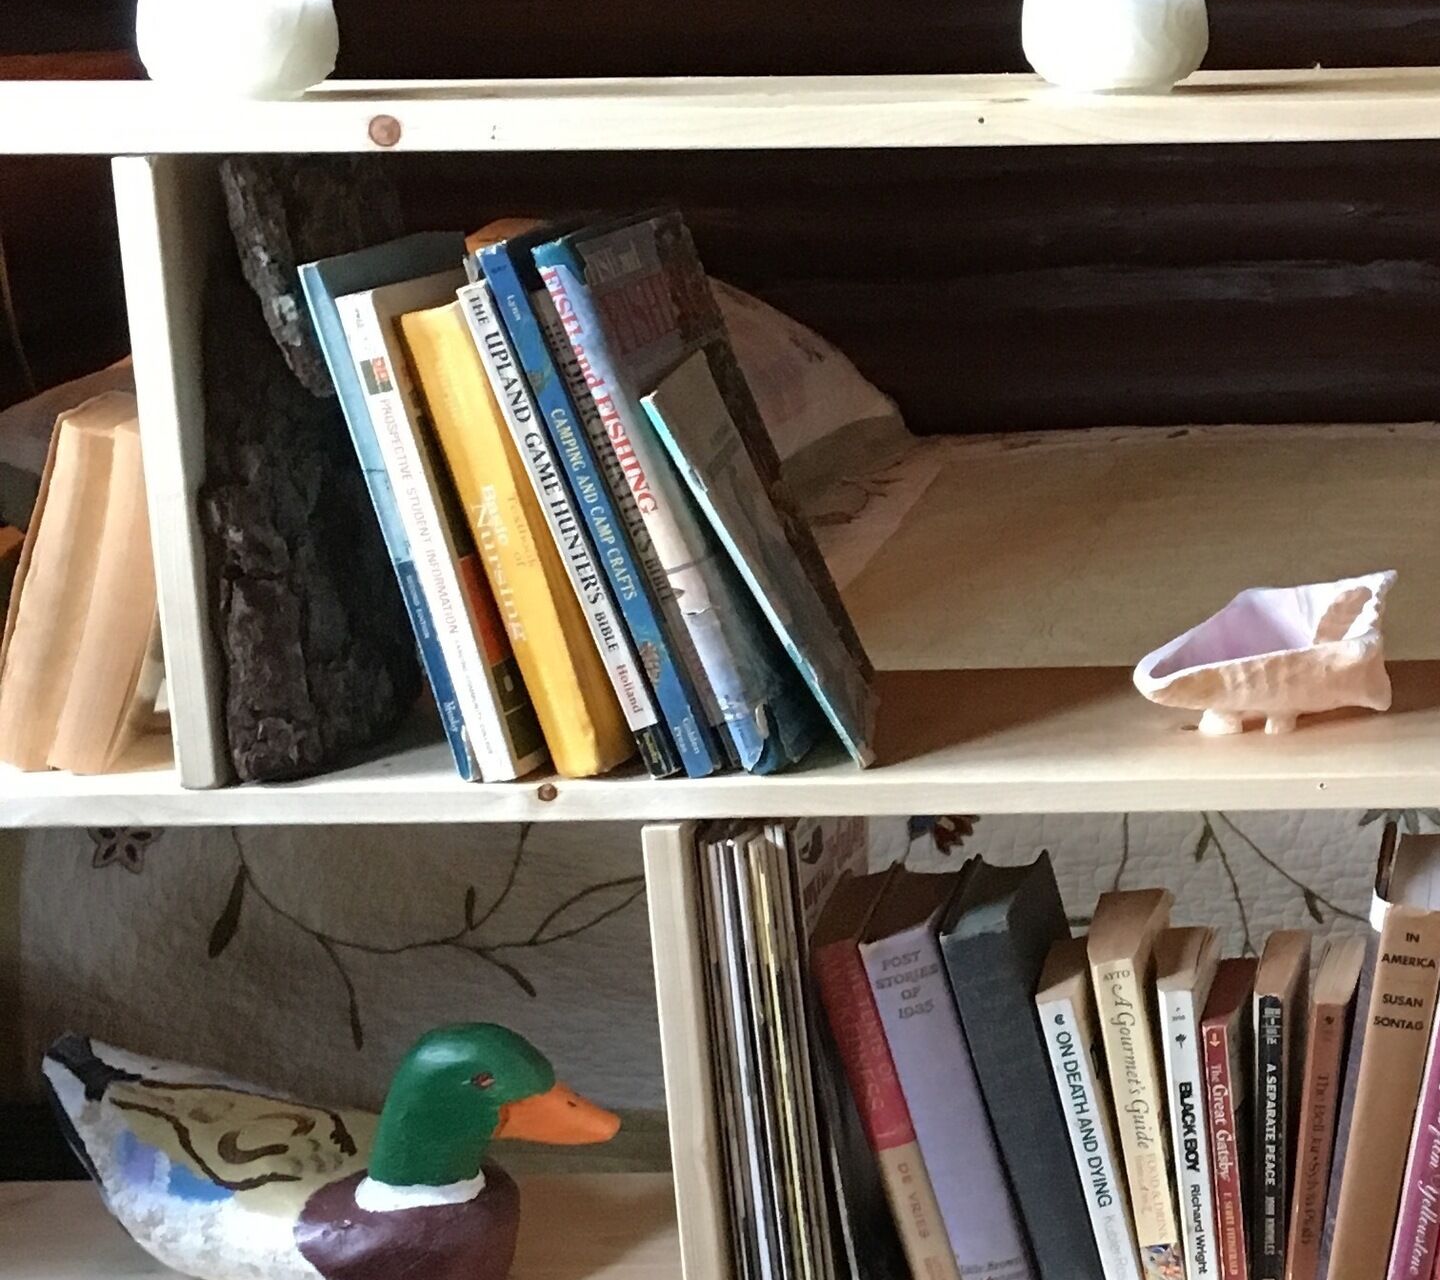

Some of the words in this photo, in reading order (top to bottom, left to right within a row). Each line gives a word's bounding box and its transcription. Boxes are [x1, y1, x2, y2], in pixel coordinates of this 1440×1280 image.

[507, 294, 521, 321] Lynn
[542, 269, 584, 337] FISH
[574, 345, 606, 389] and
[595, 393, 658, 515] FISHING
[469, 295, 490, 326] THE
[484, 330, 532, 425] UPLAND
[524, 431, 557, 497] GAME
[550, 499, 605, 605] HUNTER'S
[594, 610, 619, 652] BIBLE
[380, 398, 413, 480] PROSPECTIVE
[406, 487, 434, 544] STUDENT
[425, 547, 459, 635] INFORMATION
[551, 407, 586, 471] CAMPING
[576, 474, 599, 505] AND
[590, 505, 616, 546] CAMP
[606, 547, 637, 602] CRAFTS
[471, 505, 527, 641] Nursing
[644, 558, 674, 604] BIBLE
[616, 663, 643, 714] Holland
[1405, 931, 1421, 944] IN
[875, 961, 939, 990] STORIES
[1103, 969, 1131, 982] AYTO
[1381, 952, 1436, 969] AMERICA
[900, 986, 921, 1002] OF
[1111, 984, 1133, 1010] A
[1382, 992, 1425, 1008] SUSAN
[1373, 1014, 1426, 1031] SONTAG
[1056, 1030, 1076, 1059] ON
[1111, 1011, 1147, 1096] Gourmet's
[1063, 1056, 1091, 1115] DEATH
[1264, 1063, 1277, 1074] A
[1124, 1097, 1154, 1151] Guide
[1178, 1081, 1198, 1138] BLACK
[1210, 1083, 1230, 1126] Great
[1264, 1075, 1278, 1143] SEPARATE
[1077, 1116, 1099, 1153] AND
[1183, 1137, 1201, 1173] BOY
[1215, 1128, 1234, 1183] Gatsby
[896, 1162, 912, 1185] DE
[1087, 1155, 1113, 1209] DYING
[1264, 1143, 1277, 1187] PEACE
[1190, 1183, 1205, 1232] Richard
[1194, 1231, 1209, 1274] Wright
